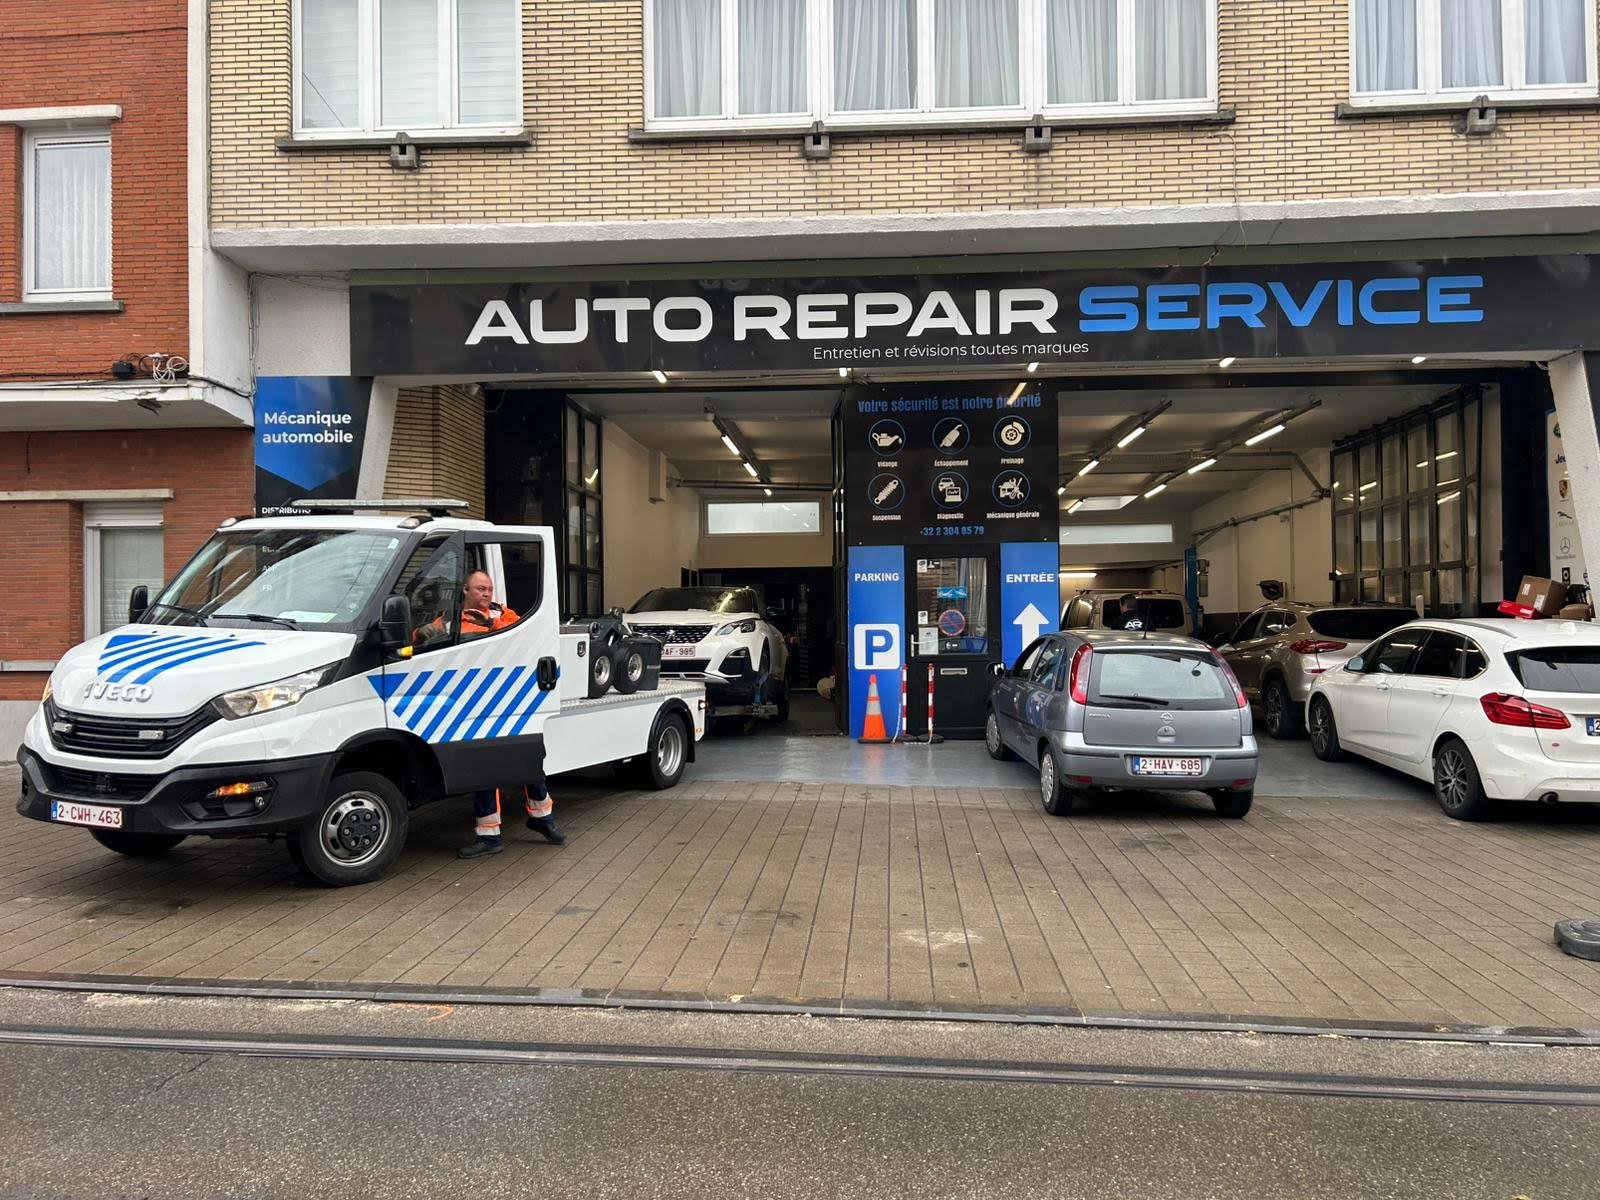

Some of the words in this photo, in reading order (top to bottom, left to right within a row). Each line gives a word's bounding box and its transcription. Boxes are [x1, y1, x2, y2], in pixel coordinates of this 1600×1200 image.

[464, 296, 713, 345] AUTO
[733, 287, 1058, 342] REPAIR
[1078, 275, 1484, 333] SERVICE
[813, 347, 881, 360] Entretien
[885, 346, 900, 358] et
[904, 344, 968, 357] révisions
[971, 344, 1018, 356] toutes
[1021, 342, 1089, 356] marques
[858, 400, 888, 413] Votre
[891, 396, 938, 412] sécurité
[942, 397, 959, 410] est
[962, 396, 992, 410] notre
[995, 393, 1041, 409] prorité
[264, 411, 352, 427] Mécanique
[262, 429, 354, 444] automobile
[854, 572, 900, 582] PARKING
[1006, 571, 1055, 583] ENTRÉE
[865, 629, 893, 665] P
[84, 682, 153, 702] IVECO
